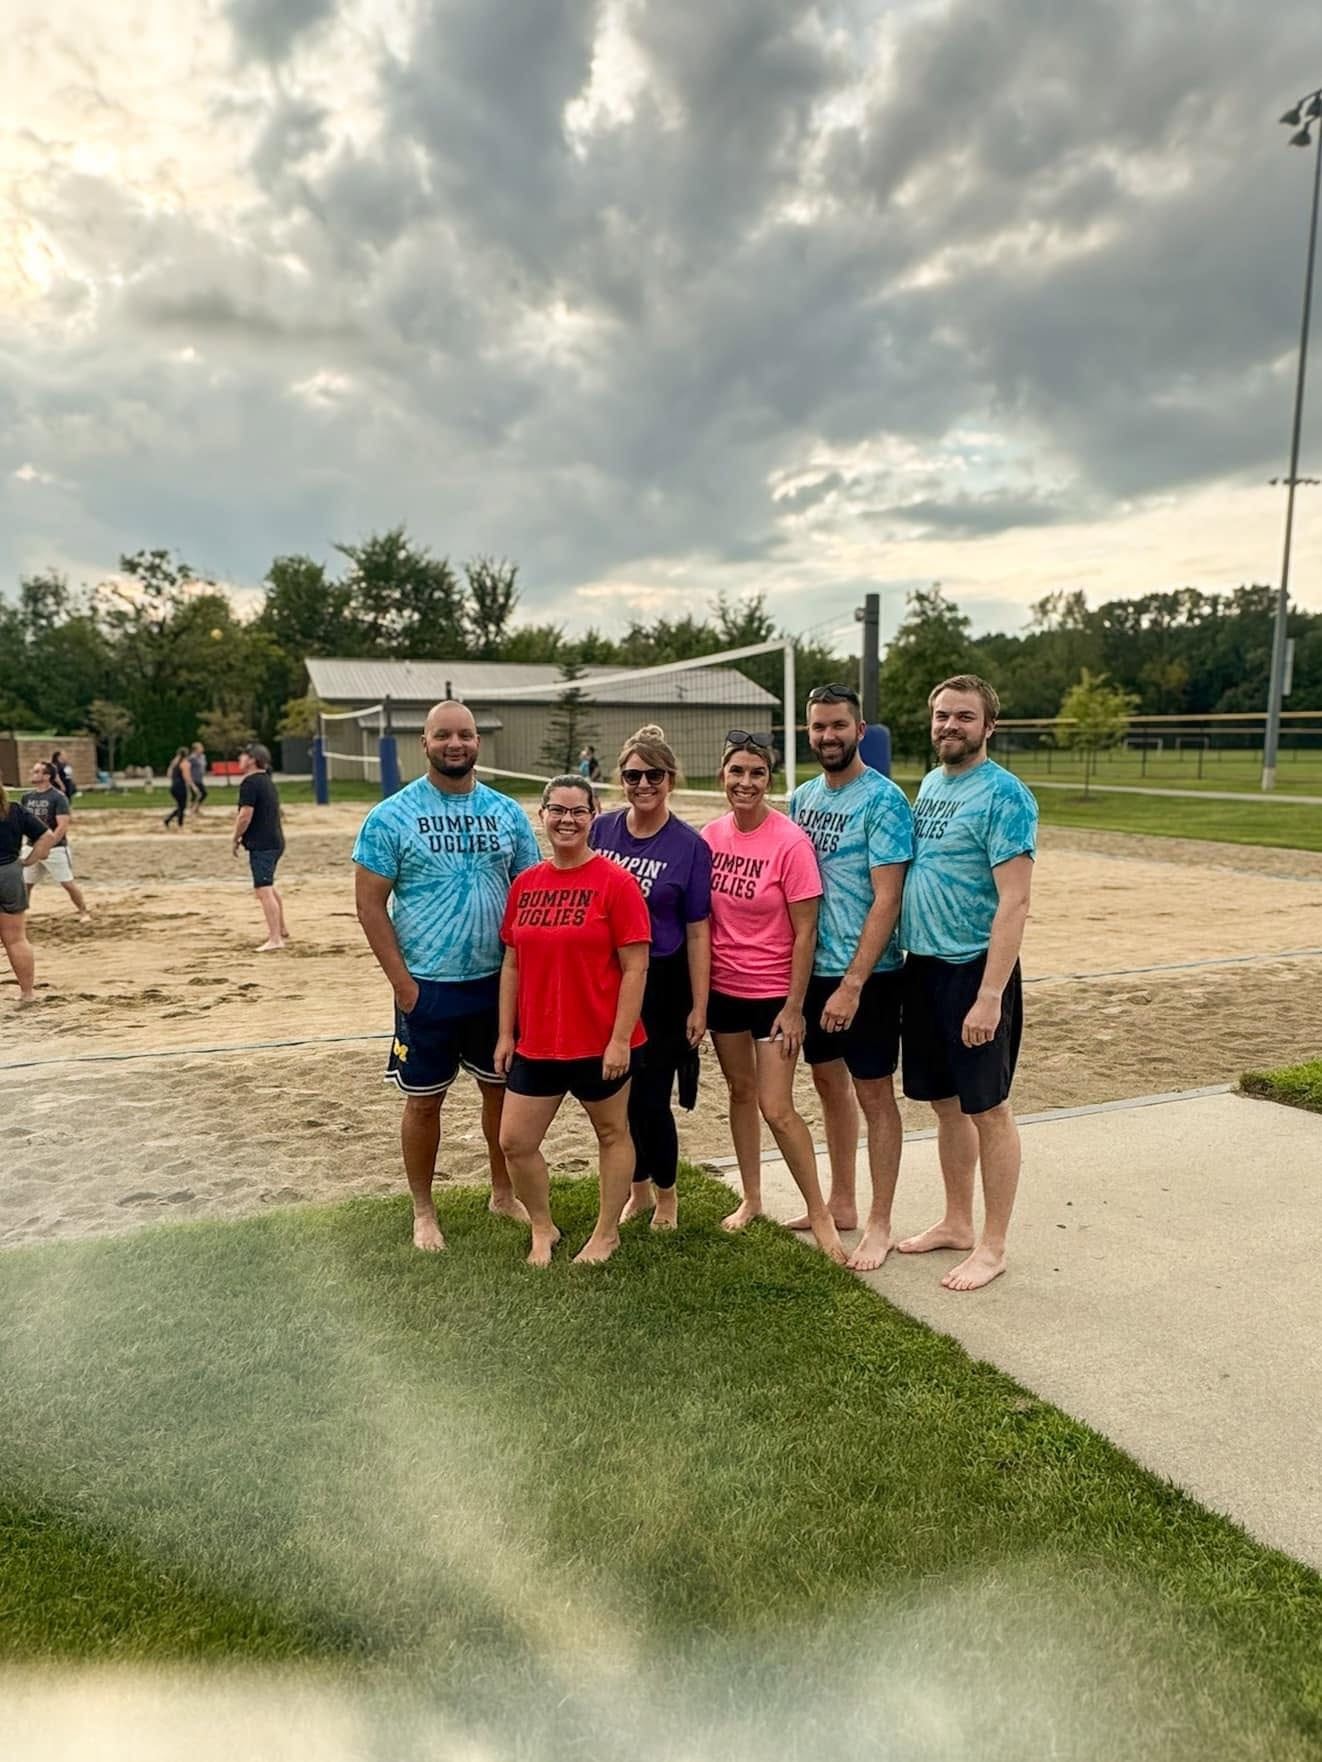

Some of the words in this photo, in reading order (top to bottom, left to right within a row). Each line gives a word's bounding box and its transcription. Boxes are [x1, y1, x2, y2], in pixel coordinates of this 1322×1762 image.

[417, 815, 501, 834] BUMPIN'
[914, 818, 948, 840] GLIES
[428, 834, 501, 854] UGLIES
[711, 851, 769, 879] UMPIN'
[711, 872, 757, 901] GLIES
[518, 908, 586, 927] UGLIES
